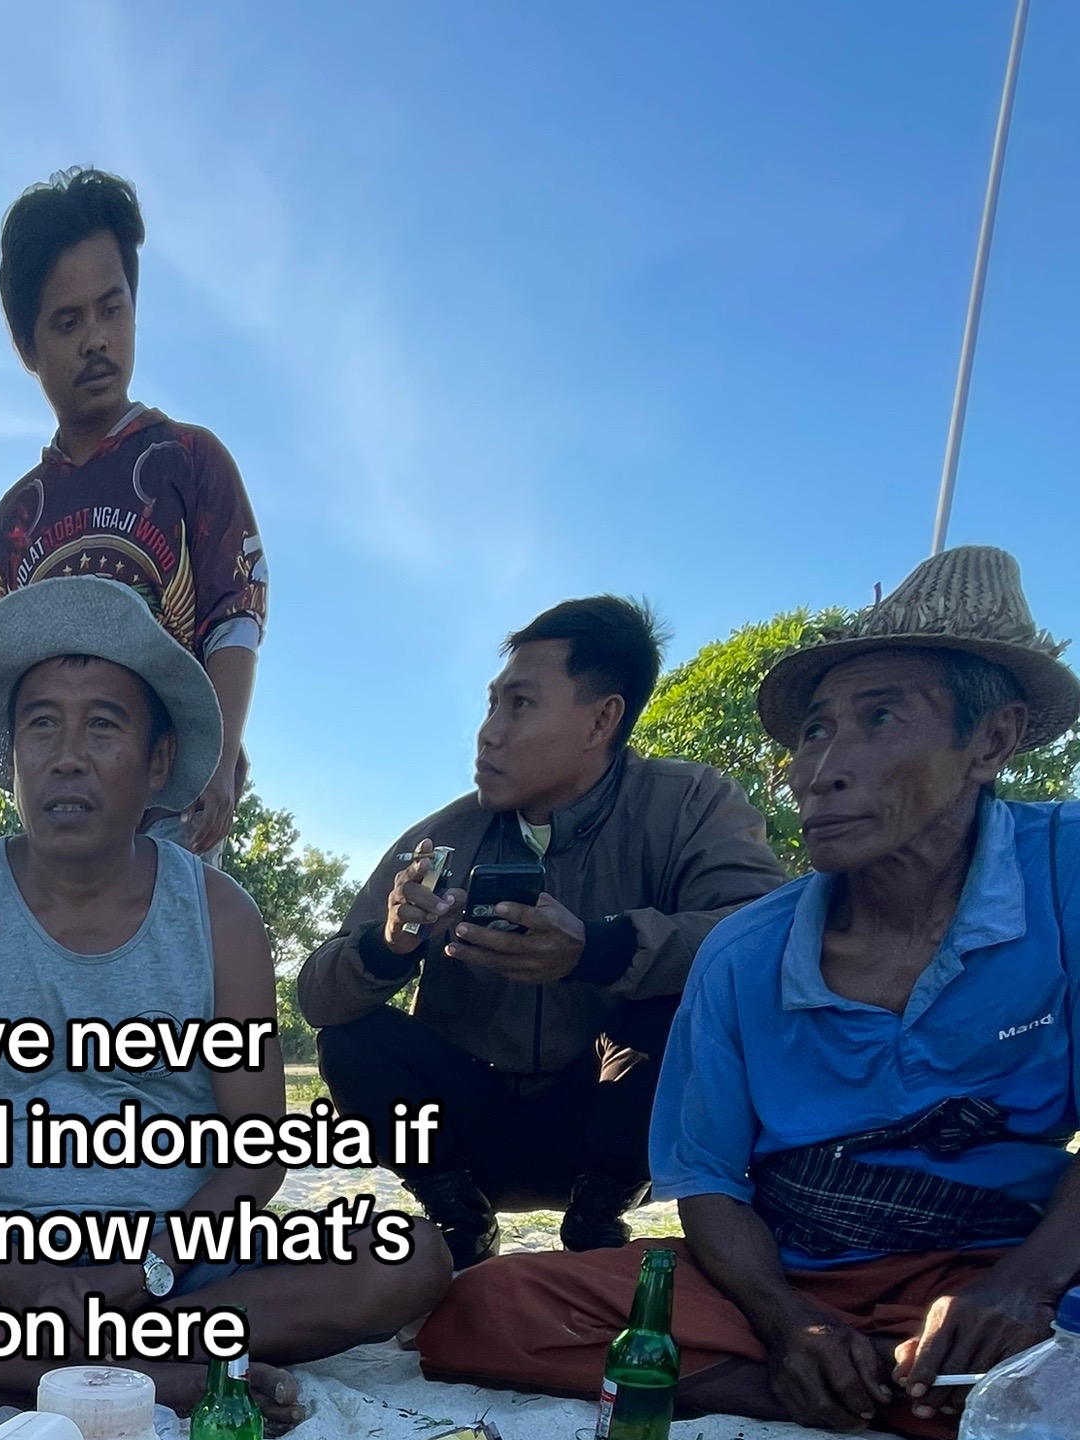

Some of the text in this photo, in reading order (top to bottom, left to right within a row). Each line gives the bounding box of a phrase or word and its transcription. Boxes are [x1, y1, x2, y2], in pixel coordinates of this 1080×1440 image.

[44, 507, 89, 547] TOBAT
[93, 506, 137, 533] NGAJI
[135, 517, 176, 572] WIRID
[998, 1013, 1053, 1040] Mand
